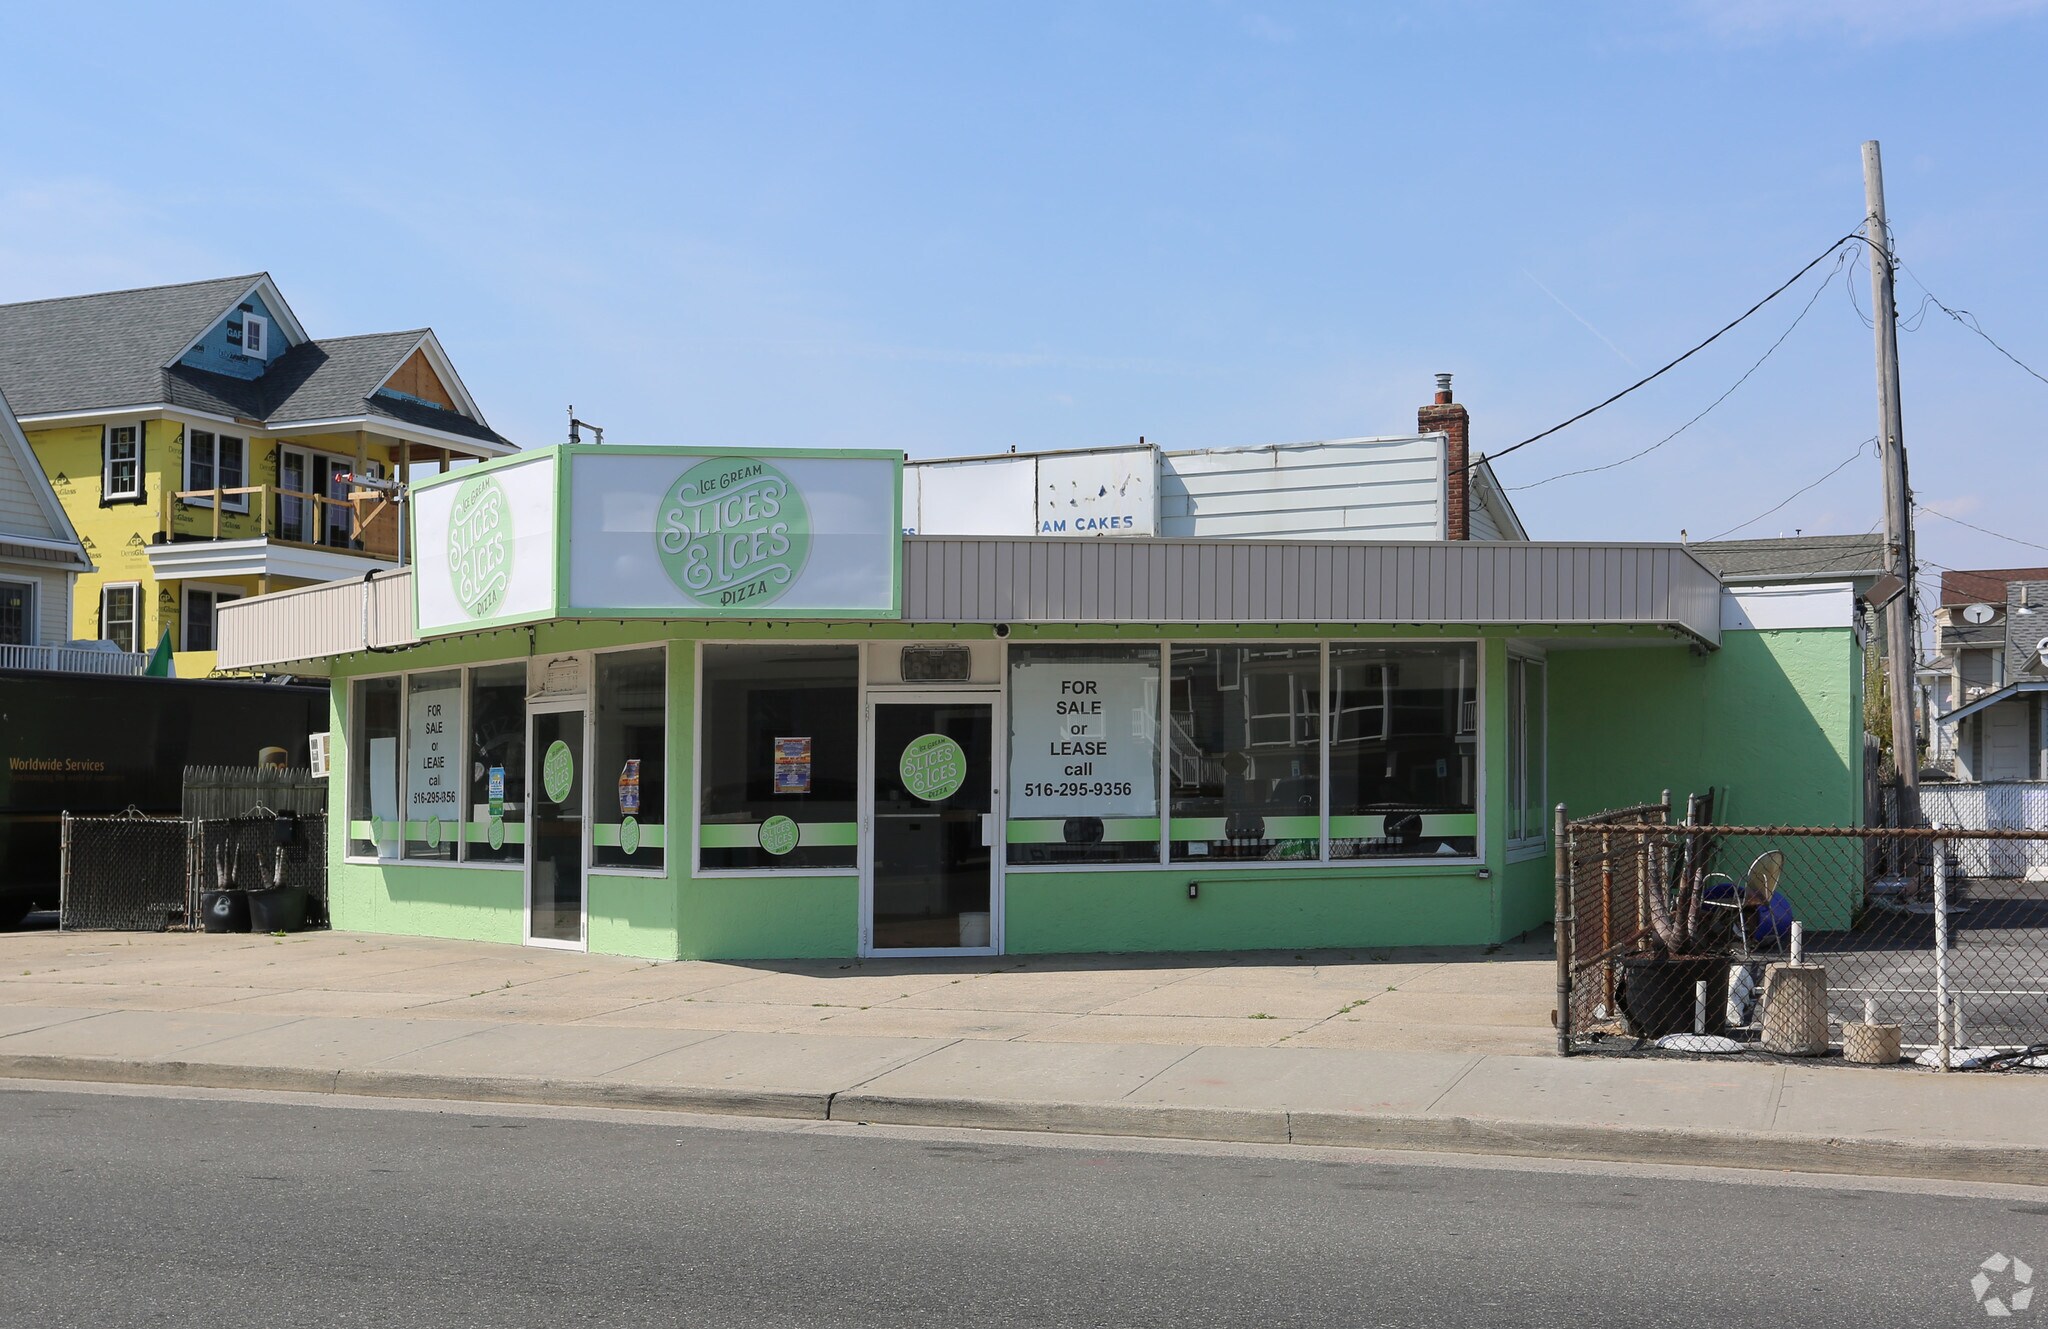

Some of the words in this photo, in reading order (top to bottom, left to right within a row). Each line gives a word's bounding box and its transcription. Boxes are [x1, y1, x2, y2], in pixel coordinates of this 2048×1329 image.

[700, 479, 716, 494] ICE
[462, 496, 470, 512] ICE
[660, 486, 781, 555] SLICES
[1075, 516, 1133, 530] CAKES
[450, 498, 499, 572] SLICES
[683, 544, 713, 590] &
[717, 522, 791, 583] ICES
[460, 561, 472, 603] &
[473, 532, 505, 594] ICES
[720, 580, 768, 606] PIZZA
[477, 590, 497, 617] PIZZA
[1061, 681, 1098, 694] FOR
[427, 704, 441, 717] FOR
[1056, 701, 1102, 715] SALE
[425, 722, 443, 734] SALE
[1071, 724, 1088, 735] or
[1050, 742, 1107, 756] LEASE
[9, 757, 63, 771] Worldwide
[65, 758, 105, 771] Services
[423, 756, 445, 769] LEASE
[903, 748, 953, 777] SLICES
[1064, 762, 1092, 776] call
[927, 763, 957, 788] ICES
[1024, 782, 1132, 797] 516-295-9356
